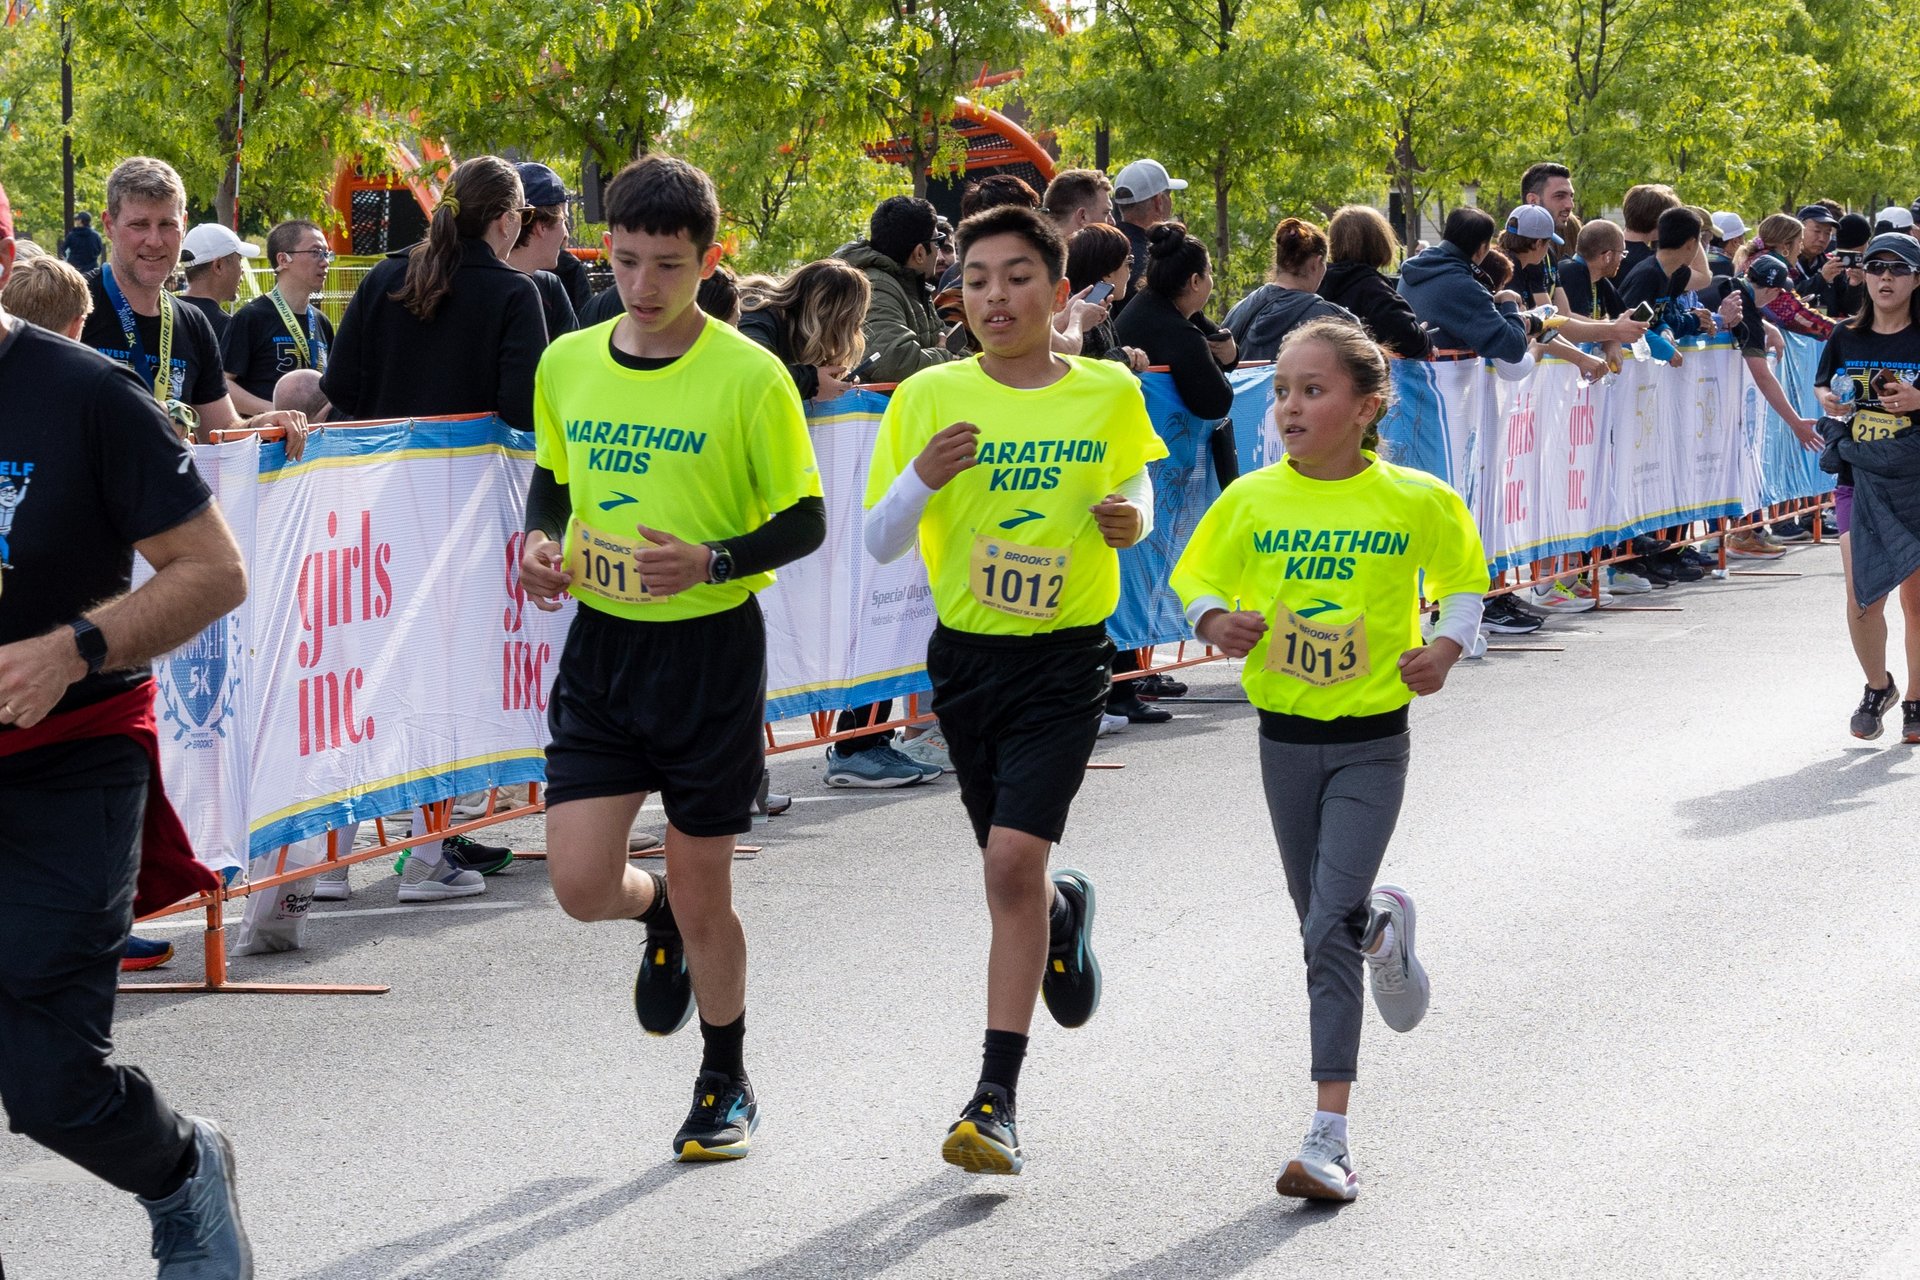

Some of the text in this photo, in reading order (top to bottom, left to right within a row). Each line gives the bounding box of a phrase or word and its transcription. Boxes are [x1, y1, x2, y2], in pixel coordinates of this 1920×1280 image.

[97, 347, 187, 367] NVEST YOSELF
[158, 327, 170, 385] BERKSHIRE
[1569, 386, 1594, 465] girls
[1869, 416, 1893, 425] BROOKS
[566, 420, 706, 454] MARATHON
[1506, 392, 1535, 477] girls
[589, 448, 651, 475] KIDS
[976, 439, 1107, 465] ARATHON
[989, 466, 1062, 491] KIDS
[1568, 469, 1587, 511] inc.
[1505, 479, 1526, 525] inc.
[593, 538, 632, 555] BROOKS
[1253, 529, 1410, 556] MARATHON
[1004, 551, 1052, 566] BROOKS
[1284, 556, 1357, 580] KIDS
[297, 510, 392, 669] girls
[871, 586, 907, 609] Special
[982, 564, 1064, 608] 1012
[1299, 624, 1341, 642] BROOKS
[1285, 632, 1357, 678] 1013
[188, 665, 212, 699] 5K
[299, 667, 375, 757] inc.
[192, 740, 214, 749] BROOKS
